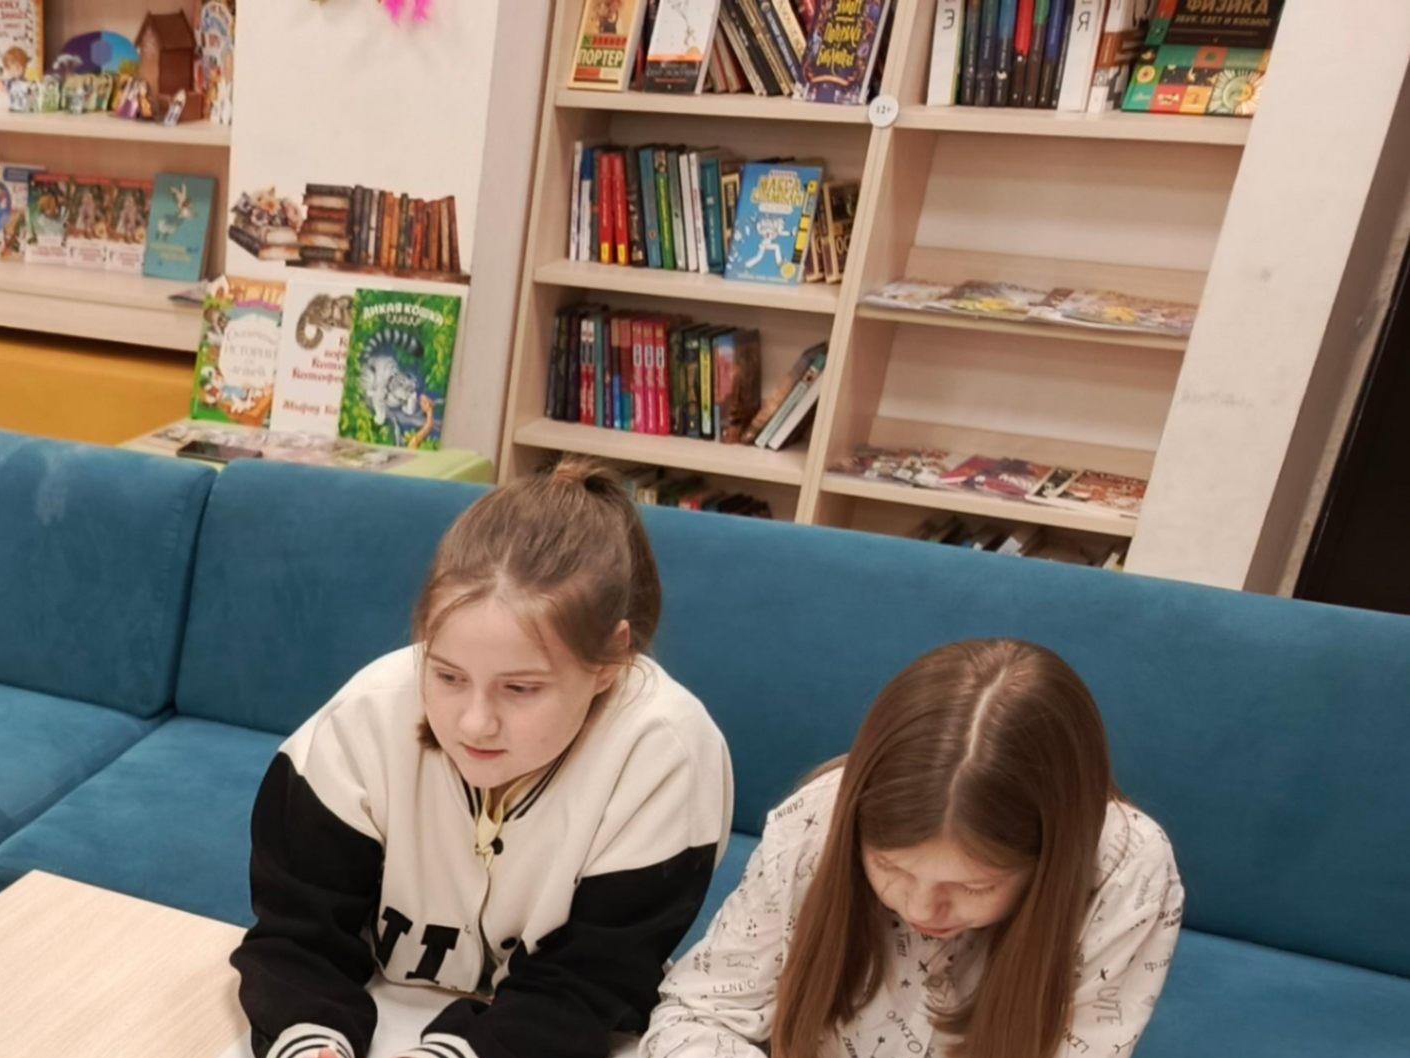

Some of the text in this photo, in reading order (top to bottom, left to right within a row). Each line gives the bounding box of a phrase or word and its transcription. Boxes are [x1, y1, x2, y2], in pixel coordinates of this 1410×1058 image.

[1077, 12, 1091, 33] Я
[577, 48, 624, 66] ПОРТЕР
[362, 302, 402, 320] ДИКАЯ
[403, 303, 443, 326] КОШКА
